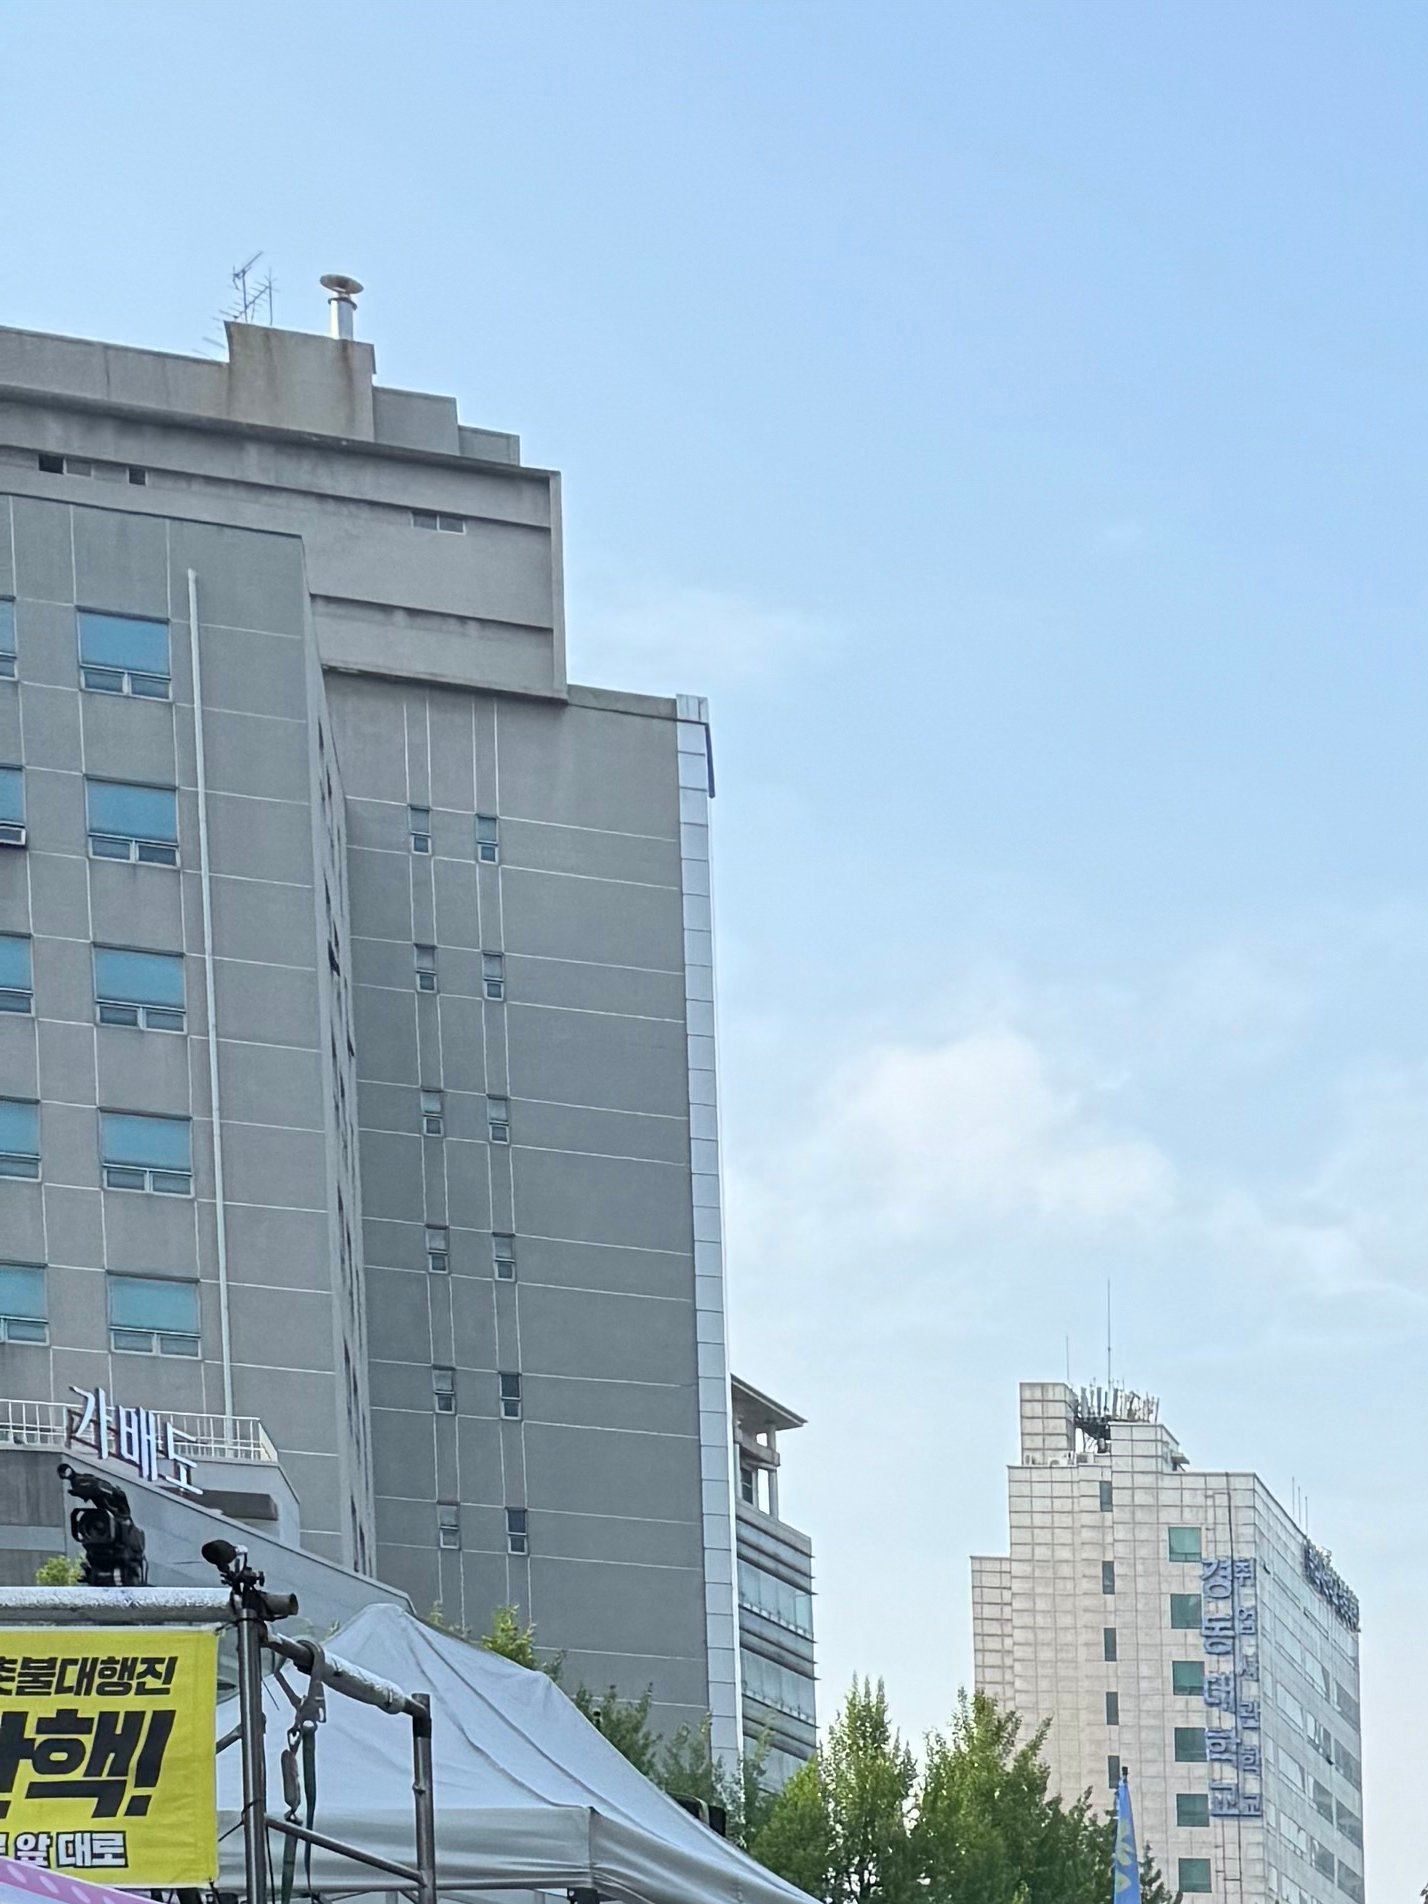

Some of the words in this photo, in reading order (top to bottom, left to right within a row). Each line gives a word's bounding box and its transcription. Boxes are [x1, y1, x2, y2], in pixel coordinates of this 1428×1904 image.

[70, 1384, 204, 1495] 가배도
[15, 1831, 53, 1868] 앞
[56, 1831, 129, 1868] 대로
